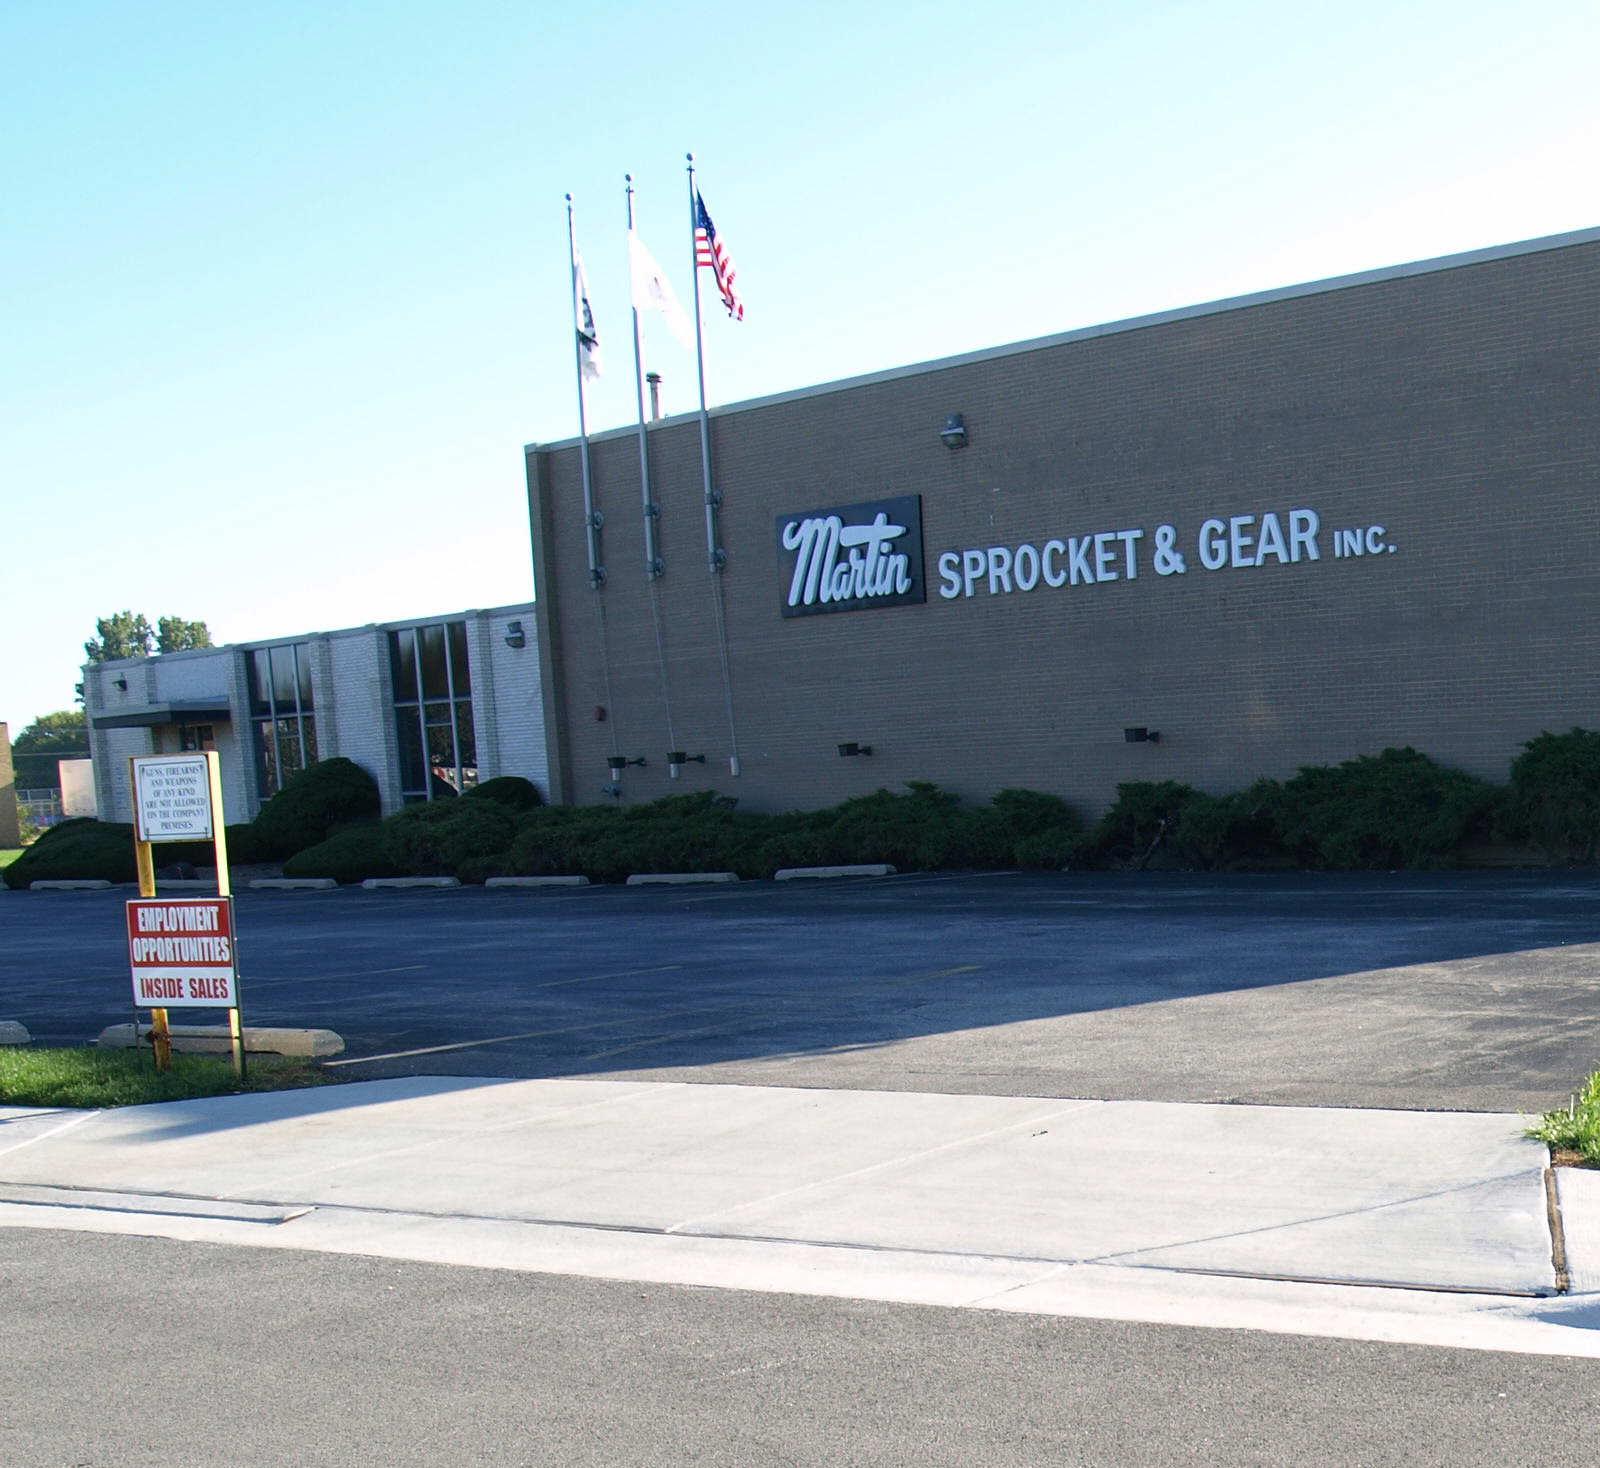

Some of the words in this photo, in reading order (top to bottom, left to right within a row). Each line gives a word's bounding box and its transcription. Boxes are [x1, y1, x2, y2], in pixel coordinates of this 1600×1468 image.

[782, 512, 912, 606] Martin
[937, 528, 1144, 600] SPROCKET
[1153, 524, 1187, 577] &
[1199, 508, 1321, 571] GEAR
[1333, 525, 1398, 559] INC.
[151, 779, 163, 787] AND
[164, 777, 197, 786] WEAPONS
[153, 790, 162, 798] OF
[164, 789, 176, 797] ANY
[178, 787, 196, 796] KIND
[145, 801, 157, 809] ARE
[159, 800, 172, 808] NOT
[173, 798, 207, 807] ALLOWED
[159, 810, 170, 818] THE
[172, 808, 205, 818] COMPANY
[160, 821, 194, 830] PREMISES
[137, 906, 219, 932] EMPLOYMENT
[132, 936, 230, 962] OPPORTUNITIES
[141, 978, 184, 999] INSIDE
[189, 978, 228, 999] SALES
